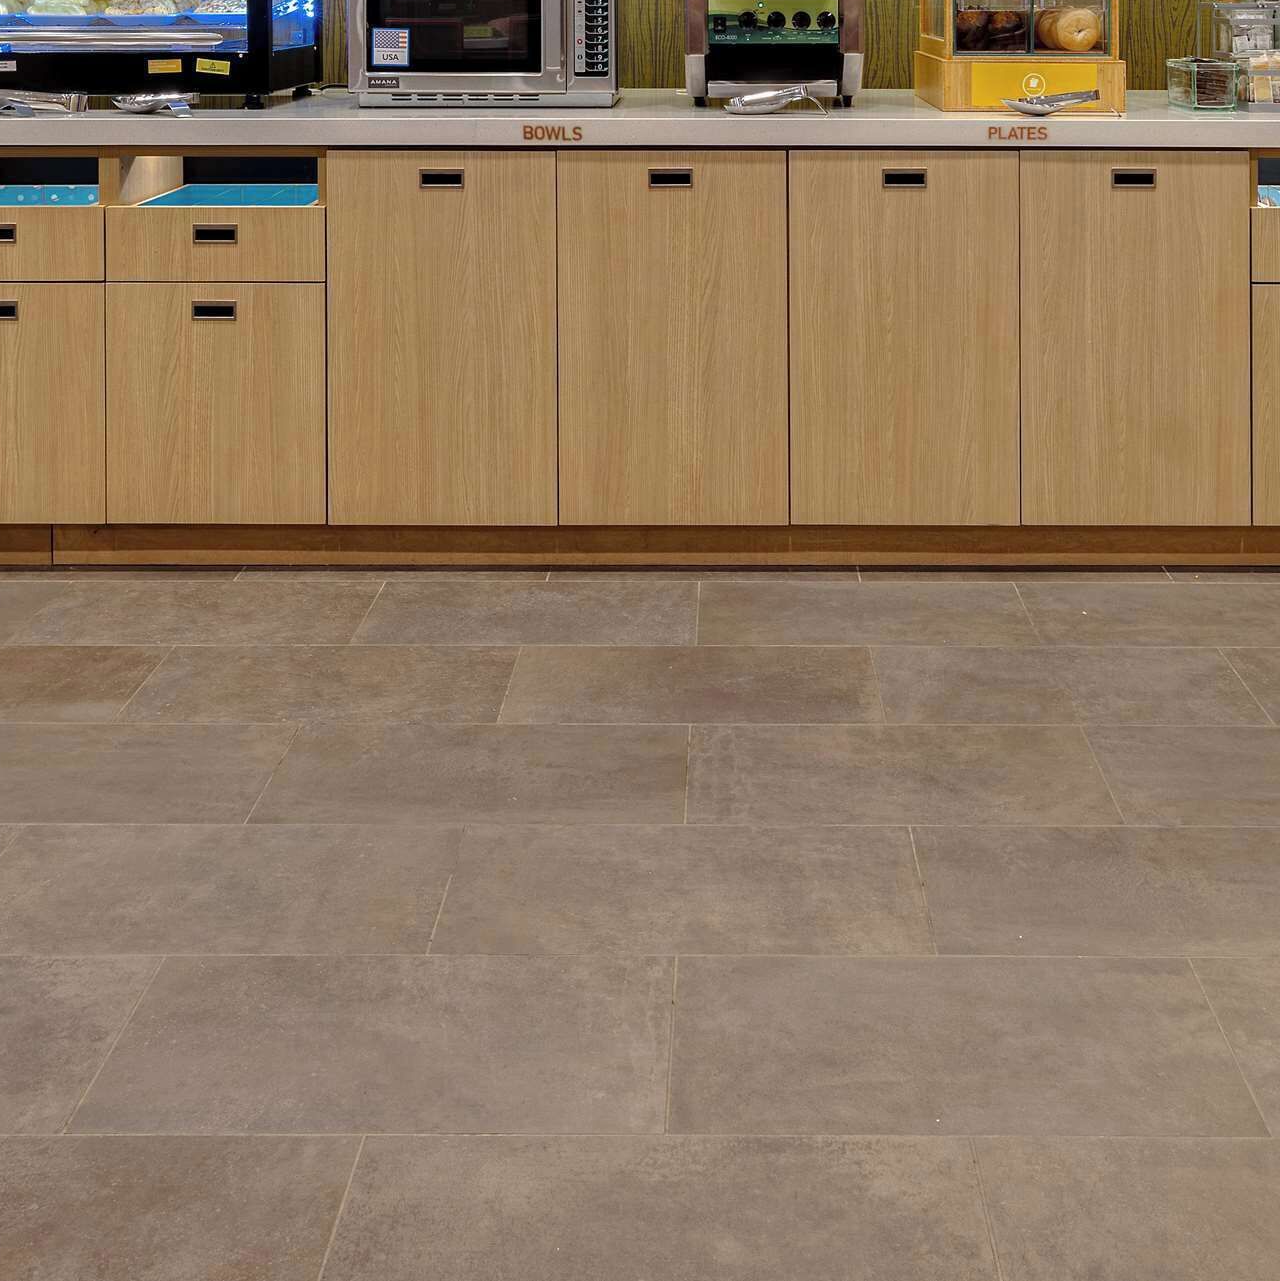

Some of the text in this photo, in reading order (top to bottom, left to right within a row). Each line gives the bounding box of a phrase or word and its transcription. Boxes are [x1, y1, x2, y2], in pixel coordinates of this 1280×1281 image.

[382, 53, 400, 61] USA
[522, 125, 583, 141] BOWLS
[988, 126, 1048, 140] PLATES
